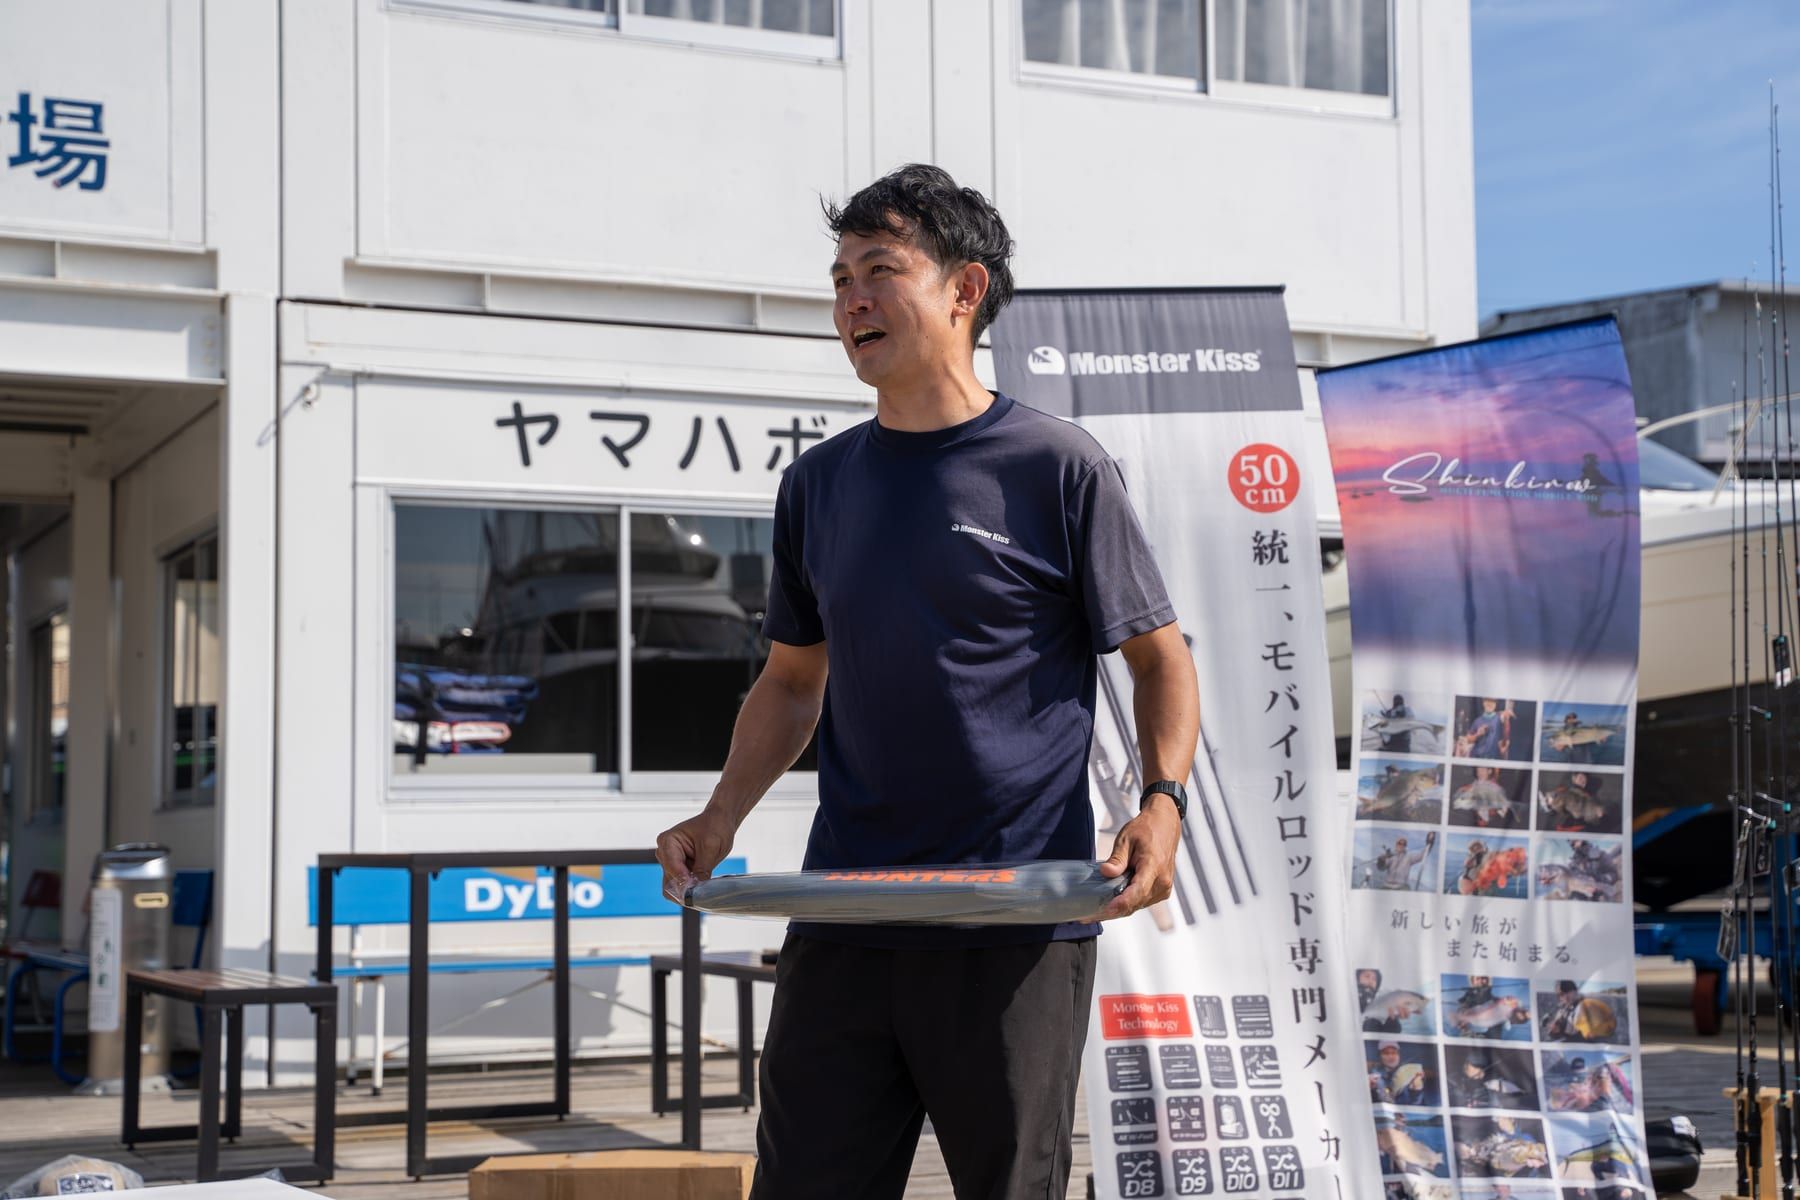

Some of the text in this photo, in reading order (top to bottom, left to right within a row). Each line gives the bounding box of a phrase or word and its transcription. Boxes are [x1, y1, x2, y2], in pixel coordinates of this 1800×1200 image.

[1069, 348, 1260, 376] Monster Kiss
[495, 401, 827, 472] ヤマハボ
[1239, 453, 1289, 487] 50
[1244, 486, 1287, 506] cm
[960, 524, 1010, 545] Monster Kiss
[464, 876, 604, 919] DyDo
[1390, 909, 1518, 936] 新しい旅が
[1156, 1001, 1179, 1014] Kiss
[1124, 1179, 1156, 1197] D8
[1181, 1176, 1207, 1193] D9
[1226, 1173, 1256, 1191] D10
[1272, 1171, 1299, 1188] D11
